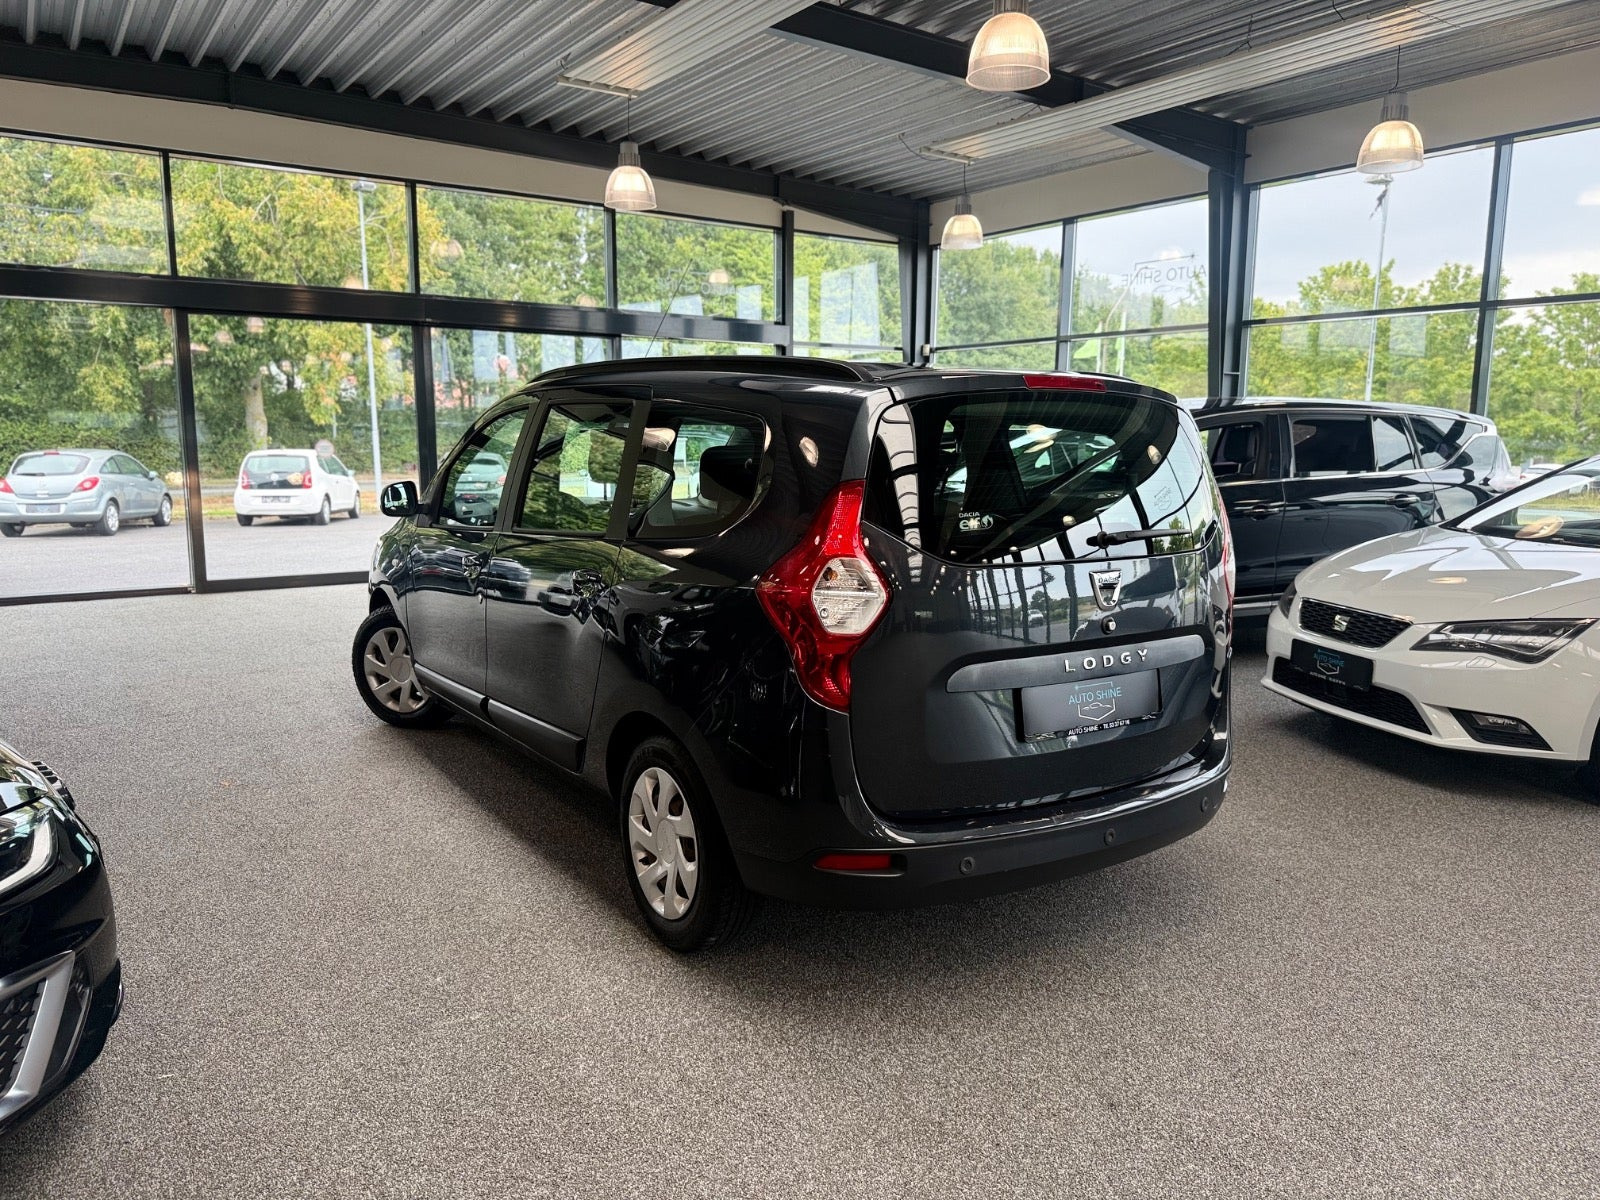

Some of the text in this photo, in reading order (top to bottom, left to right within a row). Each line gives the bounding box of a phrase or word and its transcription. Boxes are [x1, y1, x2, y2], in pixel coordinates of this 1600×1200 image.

[1064, 648, 1148, 673] LODGY
[1068, 686, 1122, 705] AUTO SHINE
[1068, 727, 1083, 736] AUTO
[1083, 724, 1099, 733] SHINE
